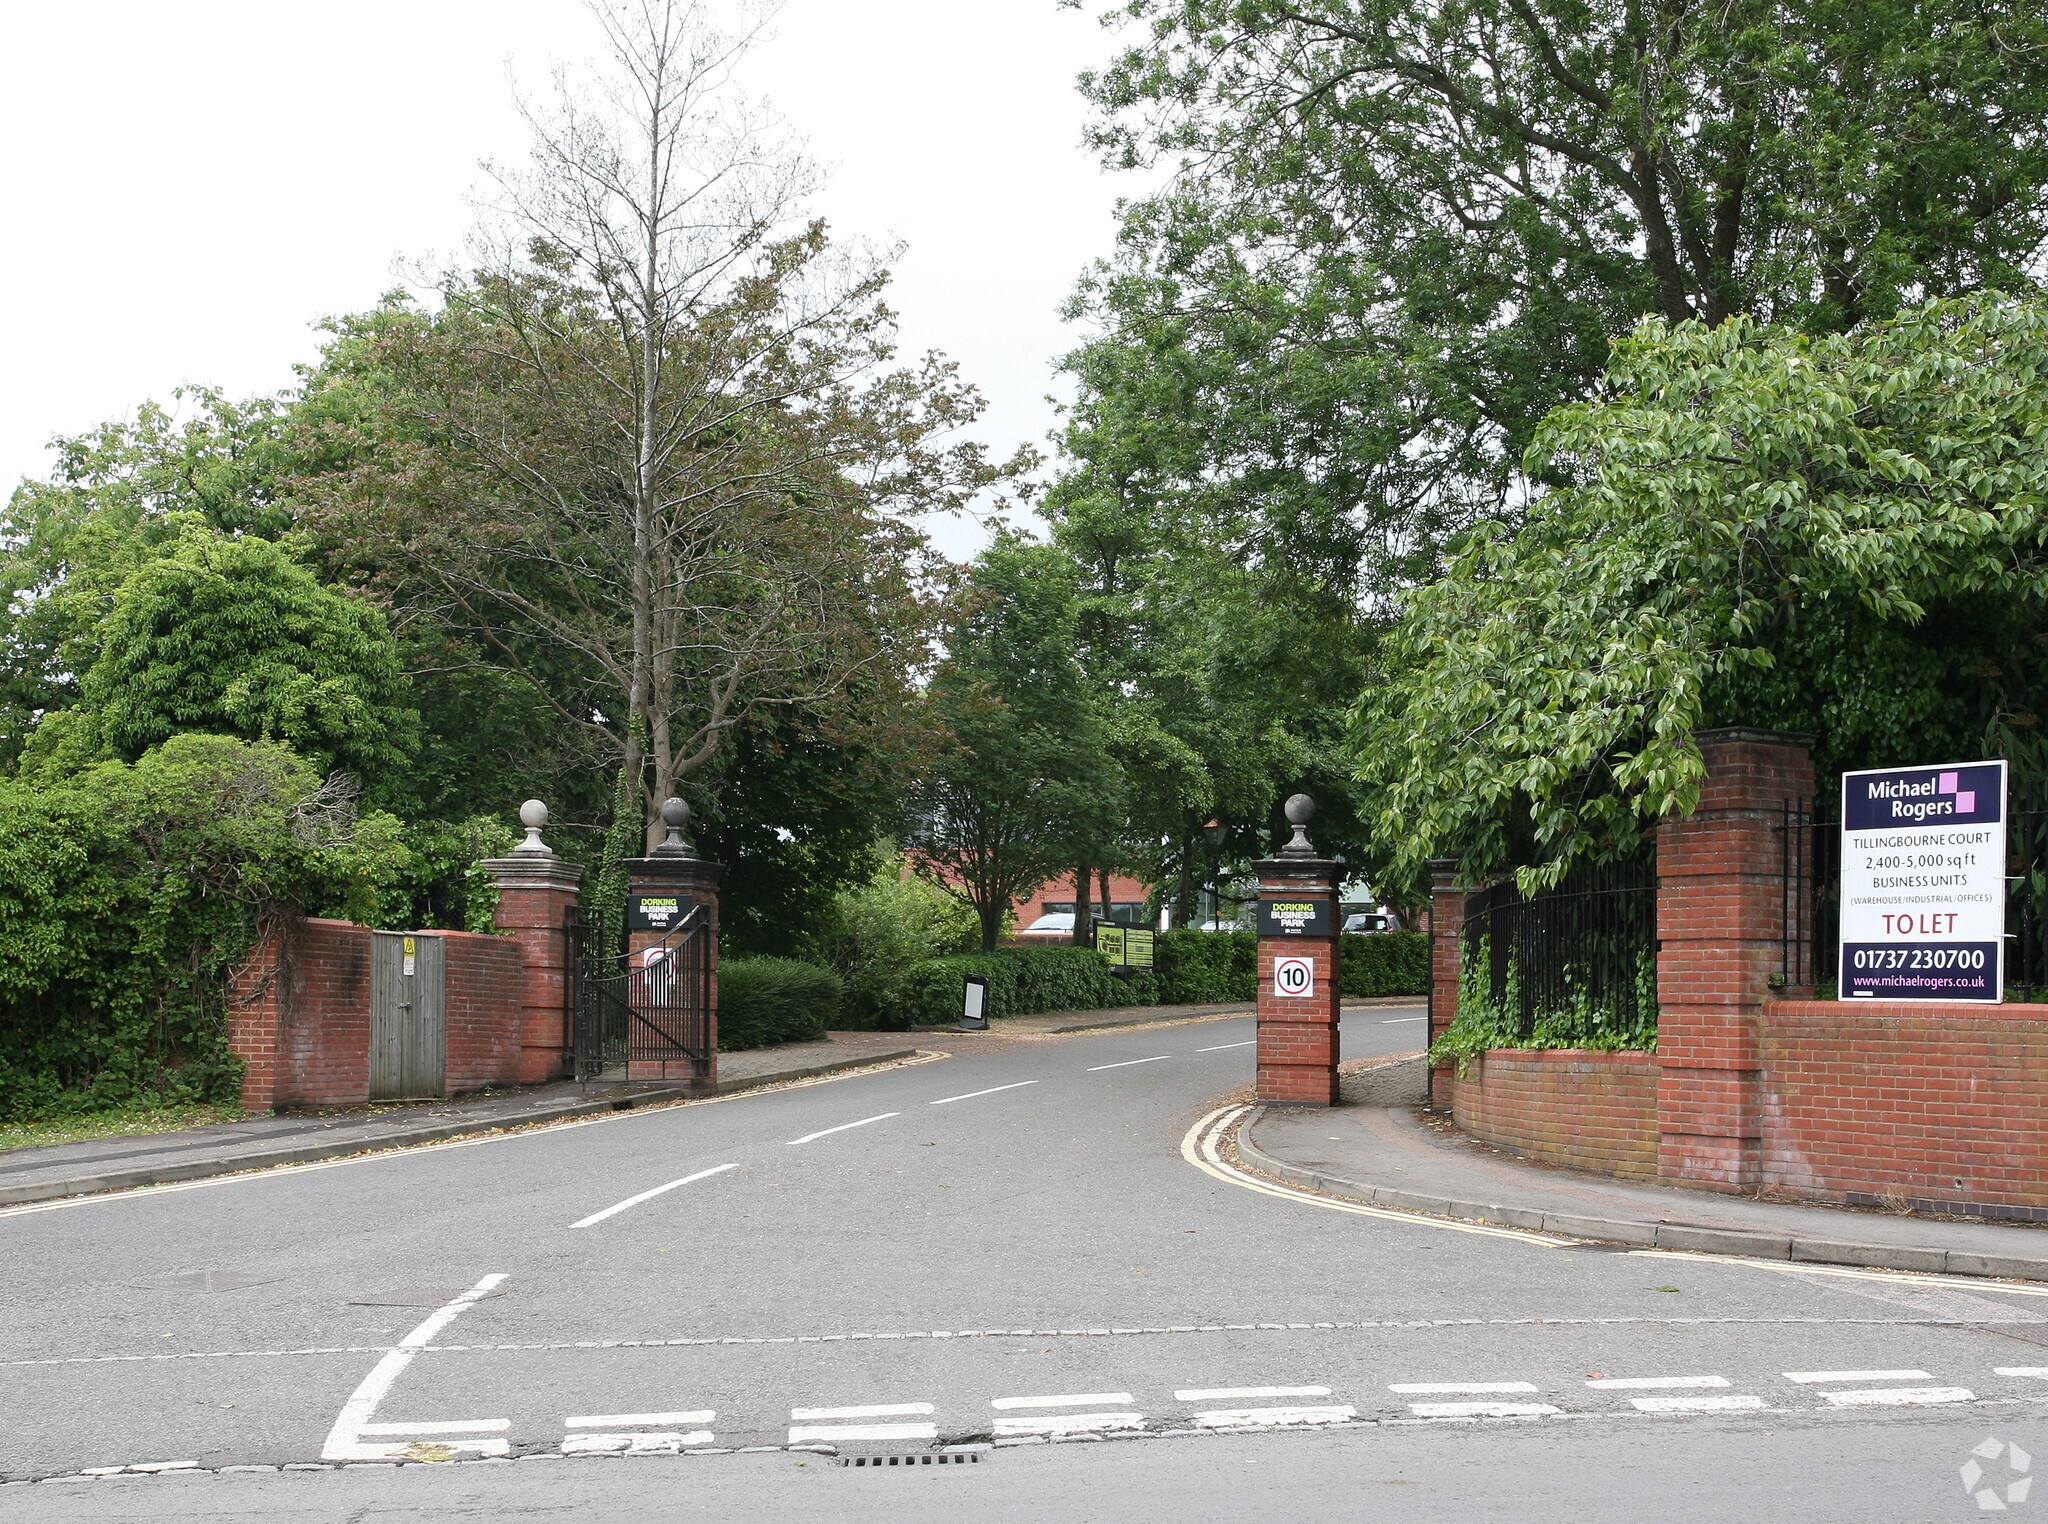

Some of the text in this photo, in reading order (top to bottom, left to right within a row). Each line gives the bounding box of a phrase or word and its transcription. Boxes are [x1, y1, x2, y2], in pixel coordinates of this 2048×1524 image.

[1868, 777, 1936, 800] Michael
[1891, 800, 1953, 821] Rogers
[1853, 832, 1991, 849] TILLINGBOURNE COURT
[1865, 853, 1976, 871] 2,400-5,000 sq ft
[1873, 874, 1967, 888] BUSINESS UNITS
[1272, 903, 1314, 911] DORKING
[1850, 893, 1993, 906] (WAREHOUSE/INDUSTRIAL/OFFICES)
[1270, 911, 1316, 919] BUSINESS
[1280, 919, 1305, 927] PARK
[1882, 913, 1958, 934] TO LET
[1853, 949, 1985, 969] 01737 230700
[1283, 968, 1305, 986] 10
[1853, 974, 1985, 990] www.michaelrogers.co.uk
